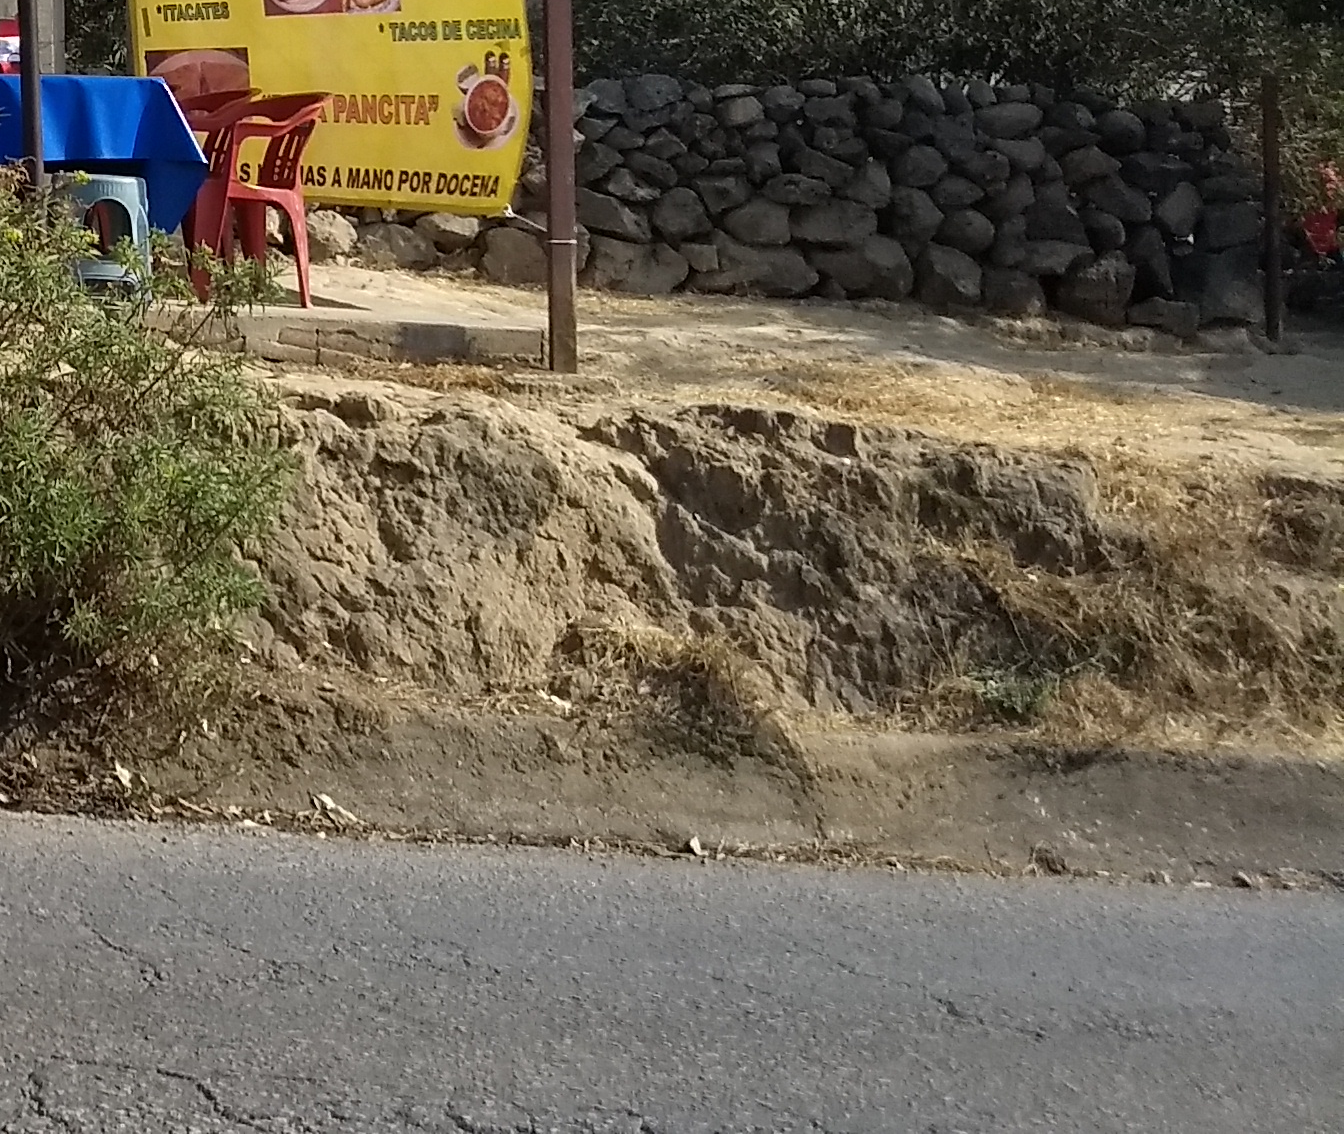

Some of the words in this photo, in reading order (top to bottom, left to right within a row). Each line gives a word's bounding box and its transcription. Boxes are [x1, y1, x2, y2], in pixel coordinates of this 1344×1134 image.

[162, 1, 230, 22] ITACATES
[389, 20, 437, 42] TACOS
[441, 20, 463, 41] DE
[465, 18, 522, 41] CECINA
[331, 167, 343, 187] A
[346, 168, 393, 192] MANO
[397, 170, 431, 194] POR
[435, 173, 500, 198] DOCENA
